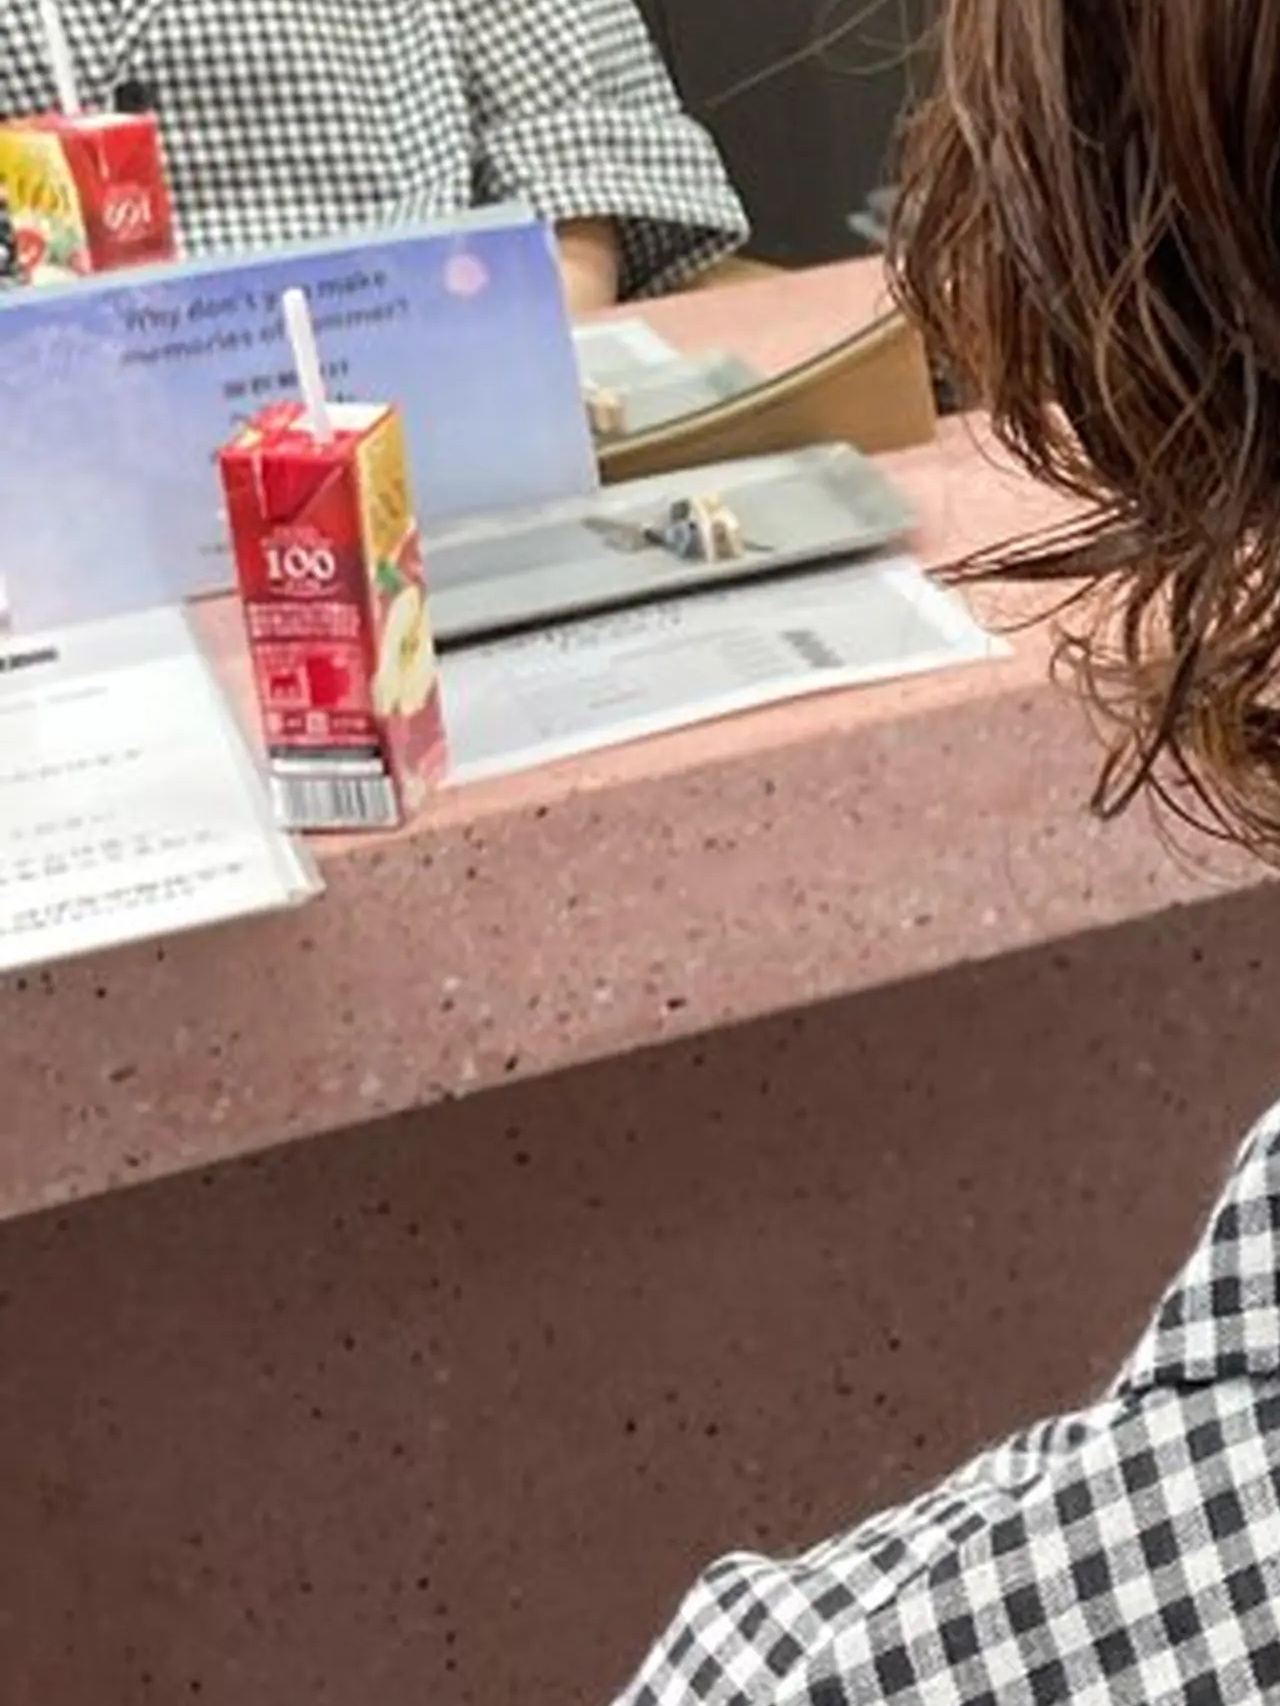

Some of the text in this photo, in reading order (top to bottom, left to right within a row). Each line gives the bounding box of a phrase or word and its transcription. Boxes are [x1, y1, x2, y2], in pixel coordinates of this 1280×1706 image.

[123, 304, 181, 332] Why
[264, 285, 312, 313] yu
[317, 270, 387, 297] make
[265, 547, 336, 581] 100
